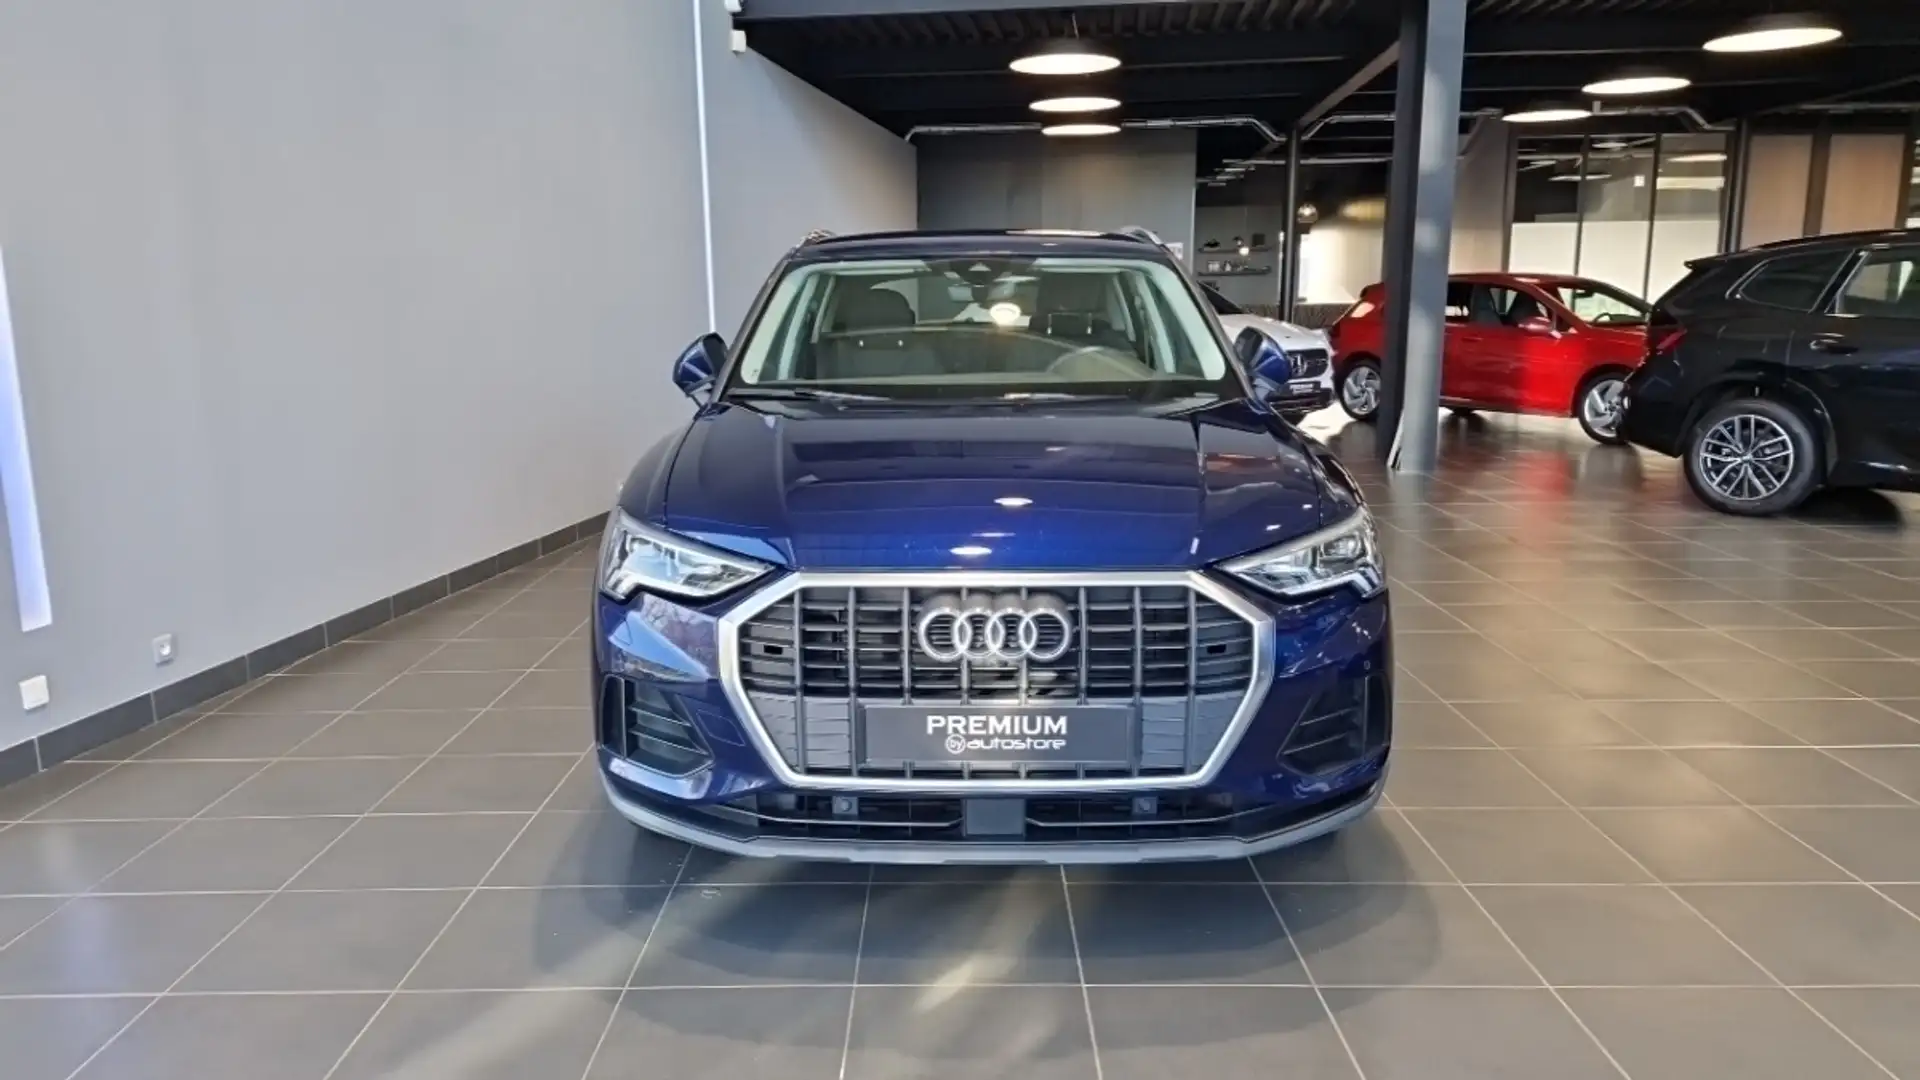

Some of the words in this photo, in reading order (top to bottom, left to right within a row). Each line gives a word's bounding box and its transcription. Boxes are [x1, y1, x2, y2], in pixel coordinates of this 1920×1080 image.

[926, 715, 1067, 735] PREMIUM
[948, 737, 964, 751] by
[967, 736, 1066, 750] autostore
